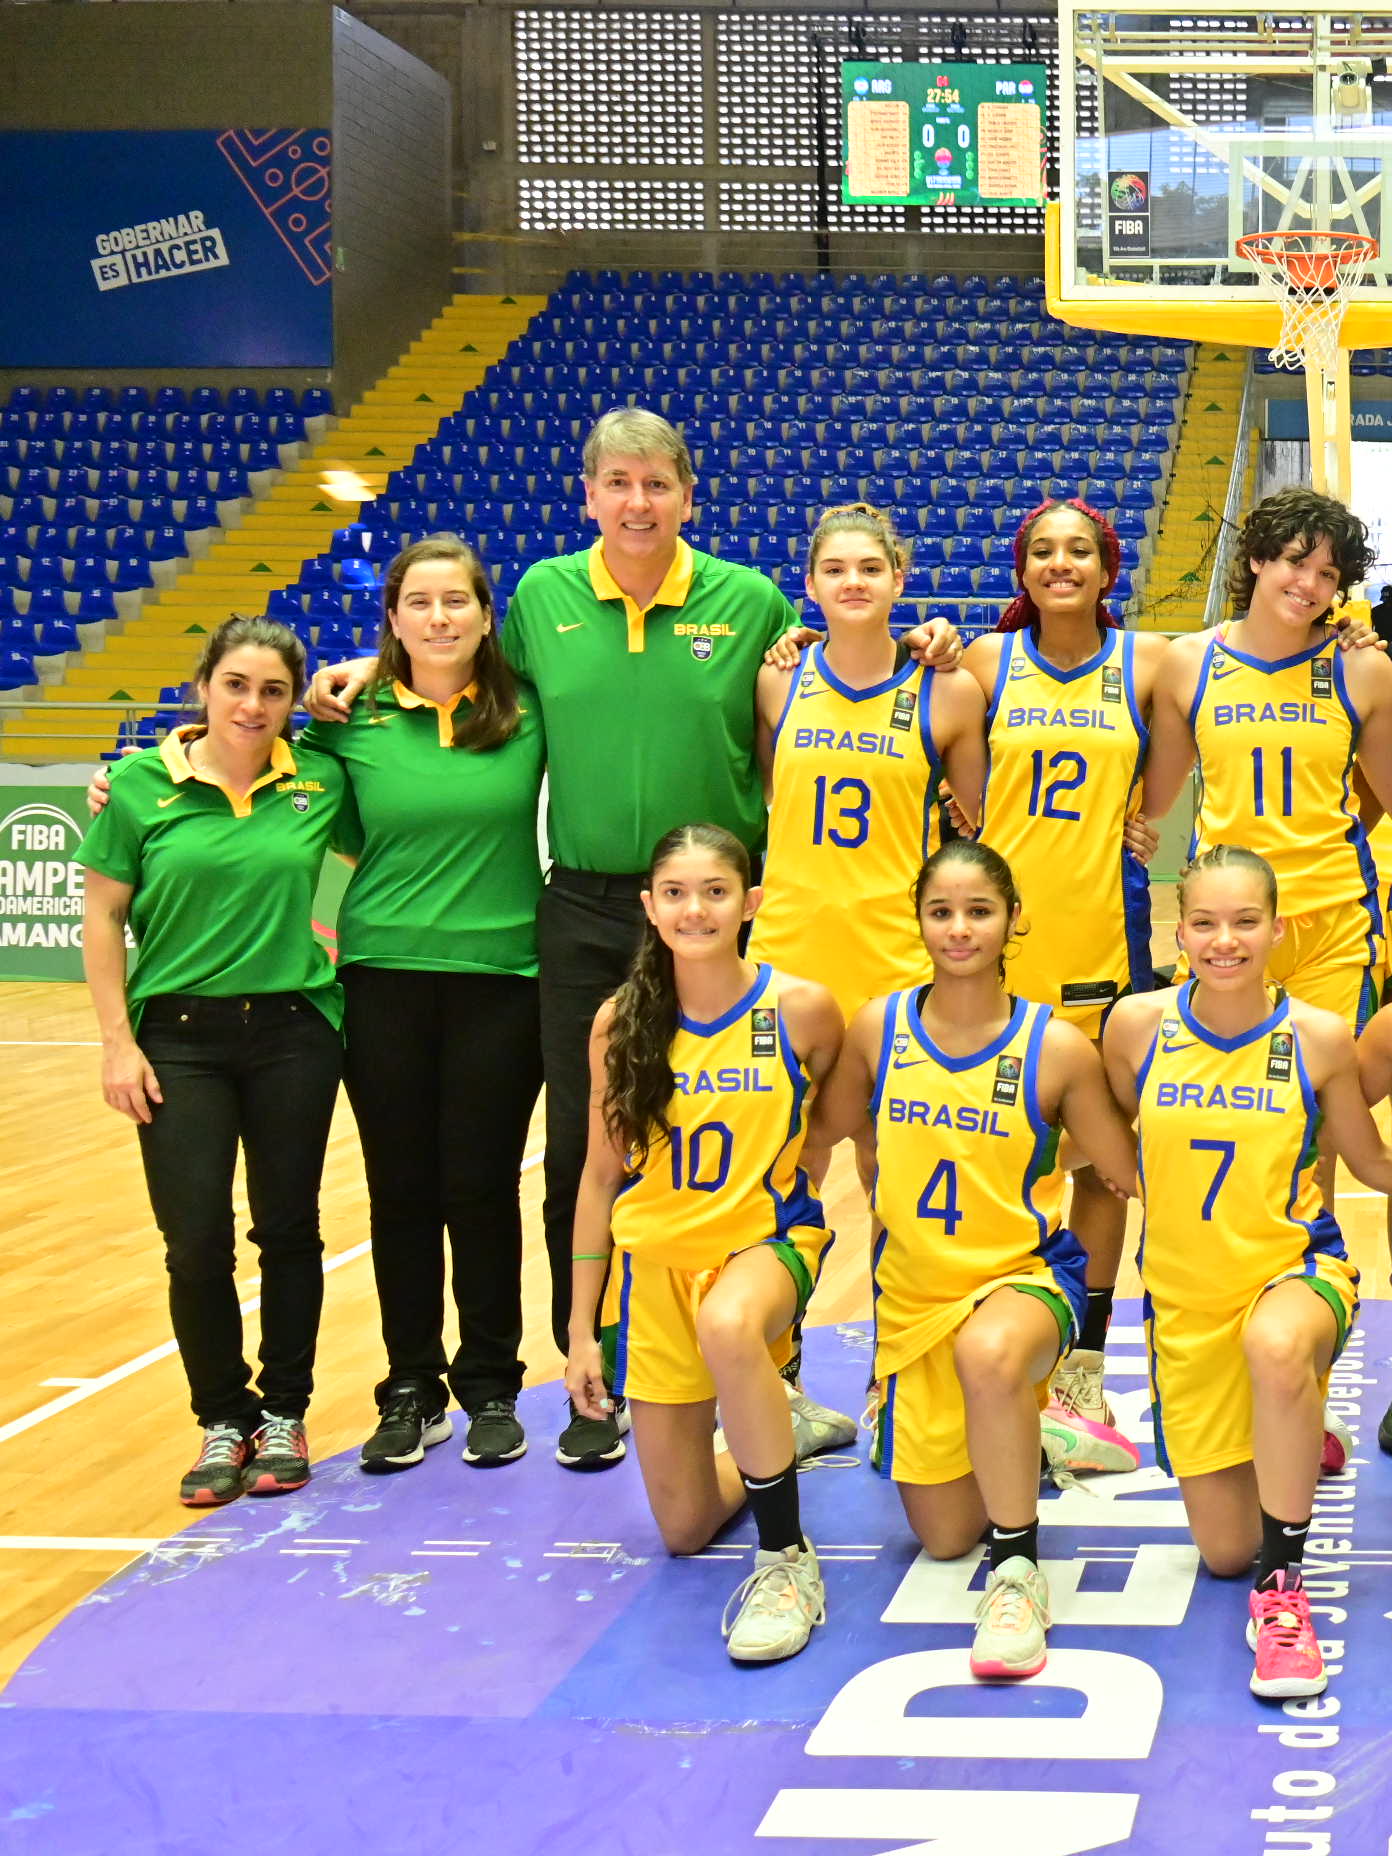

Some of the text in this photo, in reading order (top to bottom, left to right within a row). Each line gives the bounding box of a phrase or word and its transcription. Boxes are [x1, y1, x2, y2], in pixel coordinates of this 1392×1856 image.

[926, 88, 960, 103] 27:54
[996, 81, 1017, 96] PAR
[922, 124, 935, 148] 0
[957, 124, 970, 148] 0
[95, 210, 206, 255] GOBERNAR
[1114, 219, 1144, 235] FIBA
[99, 234, 222, 282] ES HACER
[673, 623, 736, 636] BRASIL
[1007, 707, 1116, 731] BRASIL
[1214, 702, 1327, 726] BRASIL
[794, 728, 905, 759] BRASIL
[275, 781, 325, 793] BRASIL
[1028, 750, 1087, 821] 12
[1251, 746, 1292, 817] 11
[812, 775, 871, 849] 13
[11, 824, 66, 851] FIBA
[672, 1068, 773, 1096] RASIL
[1156, 1082, 1286, 1114] BRASIL
[888, 1098, 1010, 1138] BRASIL
[671, 1121, 734, 1193] 10
[1189, 1139, 1237, 1221] 7
[916, 1158, 963, 1236] 4
